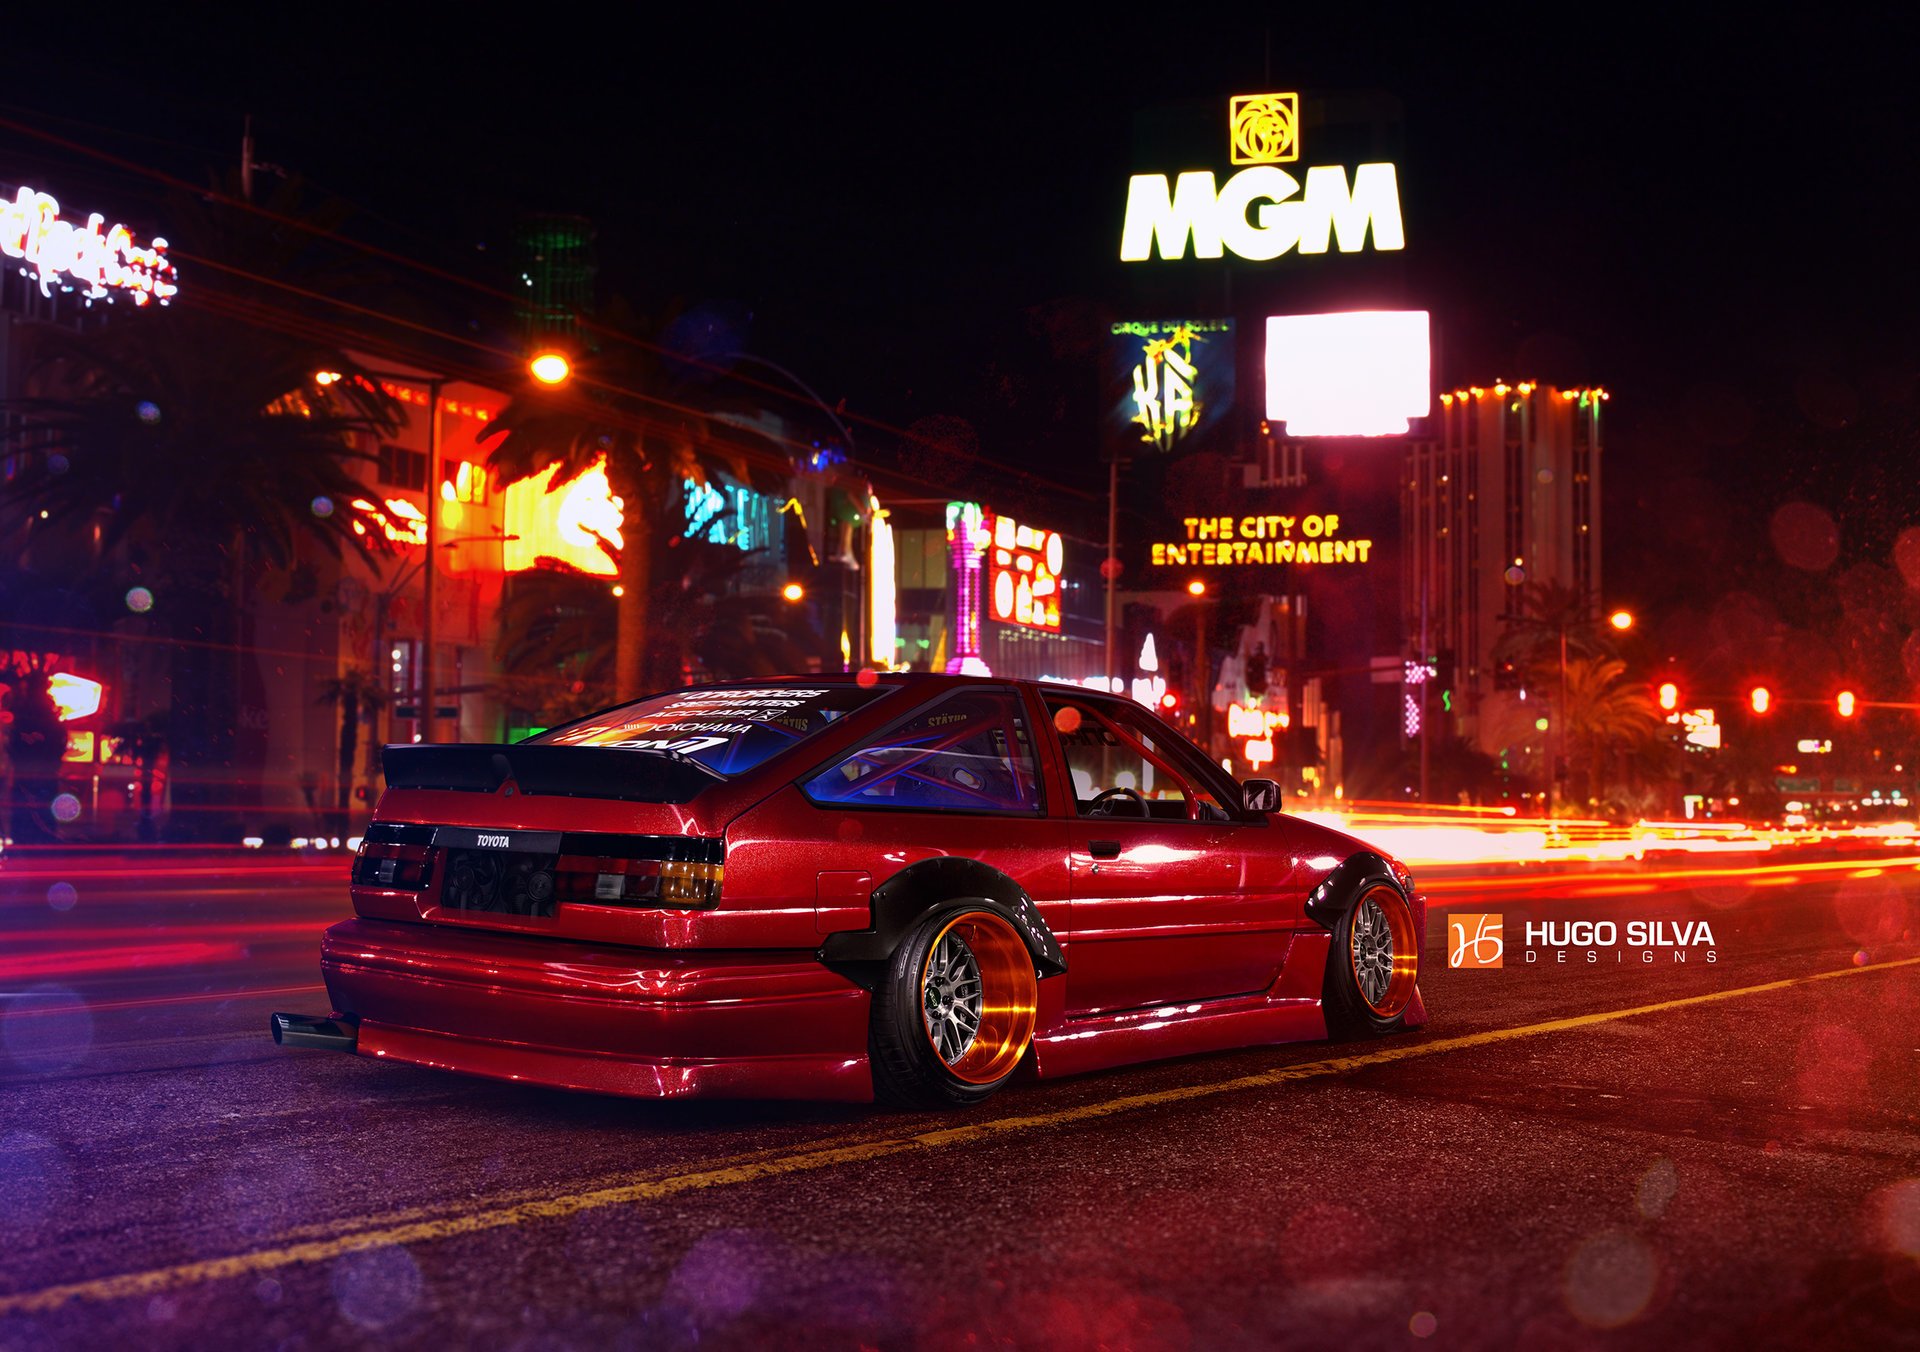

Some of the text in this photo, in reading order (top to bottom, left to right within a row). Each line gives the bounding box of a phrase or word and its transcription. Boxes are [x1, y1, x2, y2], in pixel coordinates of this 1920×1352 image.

[1120, 162, 1405, 262] MGM
[1111, 321, 1160, 336] CIRQUE
[1184, 514, 1339, 540] THE CITY OF
[1151, 540, 1372, 566] ENTERTAINMENT
[644, 722, 752, 734] YOKOHAMA
[477, 834, 510, 848] TOYOTA
